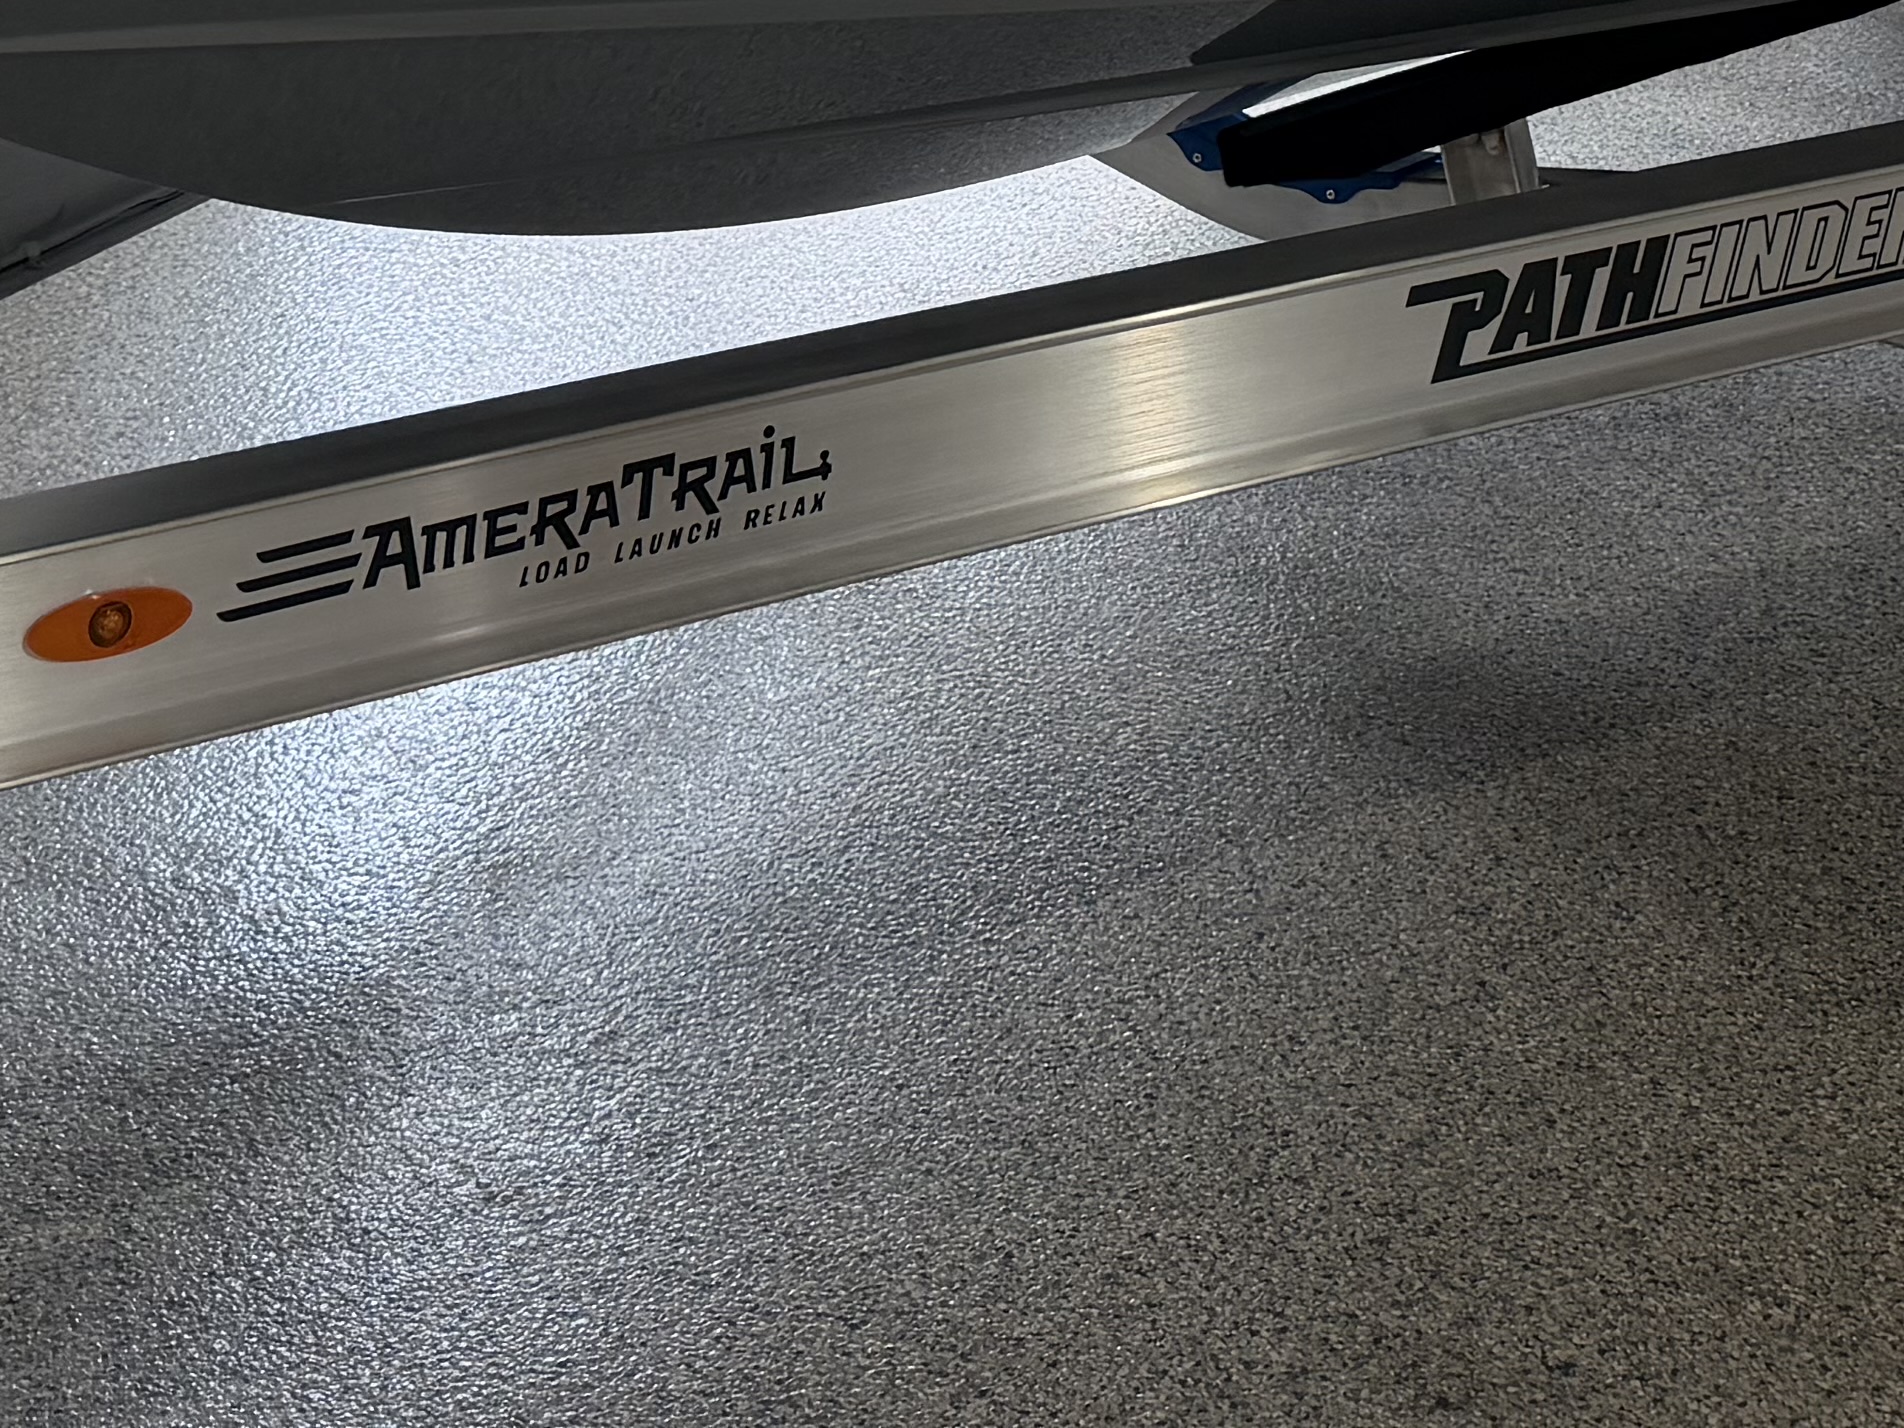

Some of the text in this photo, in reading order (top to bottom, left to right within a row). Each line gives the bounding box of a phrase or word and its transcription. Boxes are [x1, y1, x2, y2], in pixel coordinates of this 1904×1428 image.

[518, 491, 827, 588] LOAD LAUNCH RELAX
